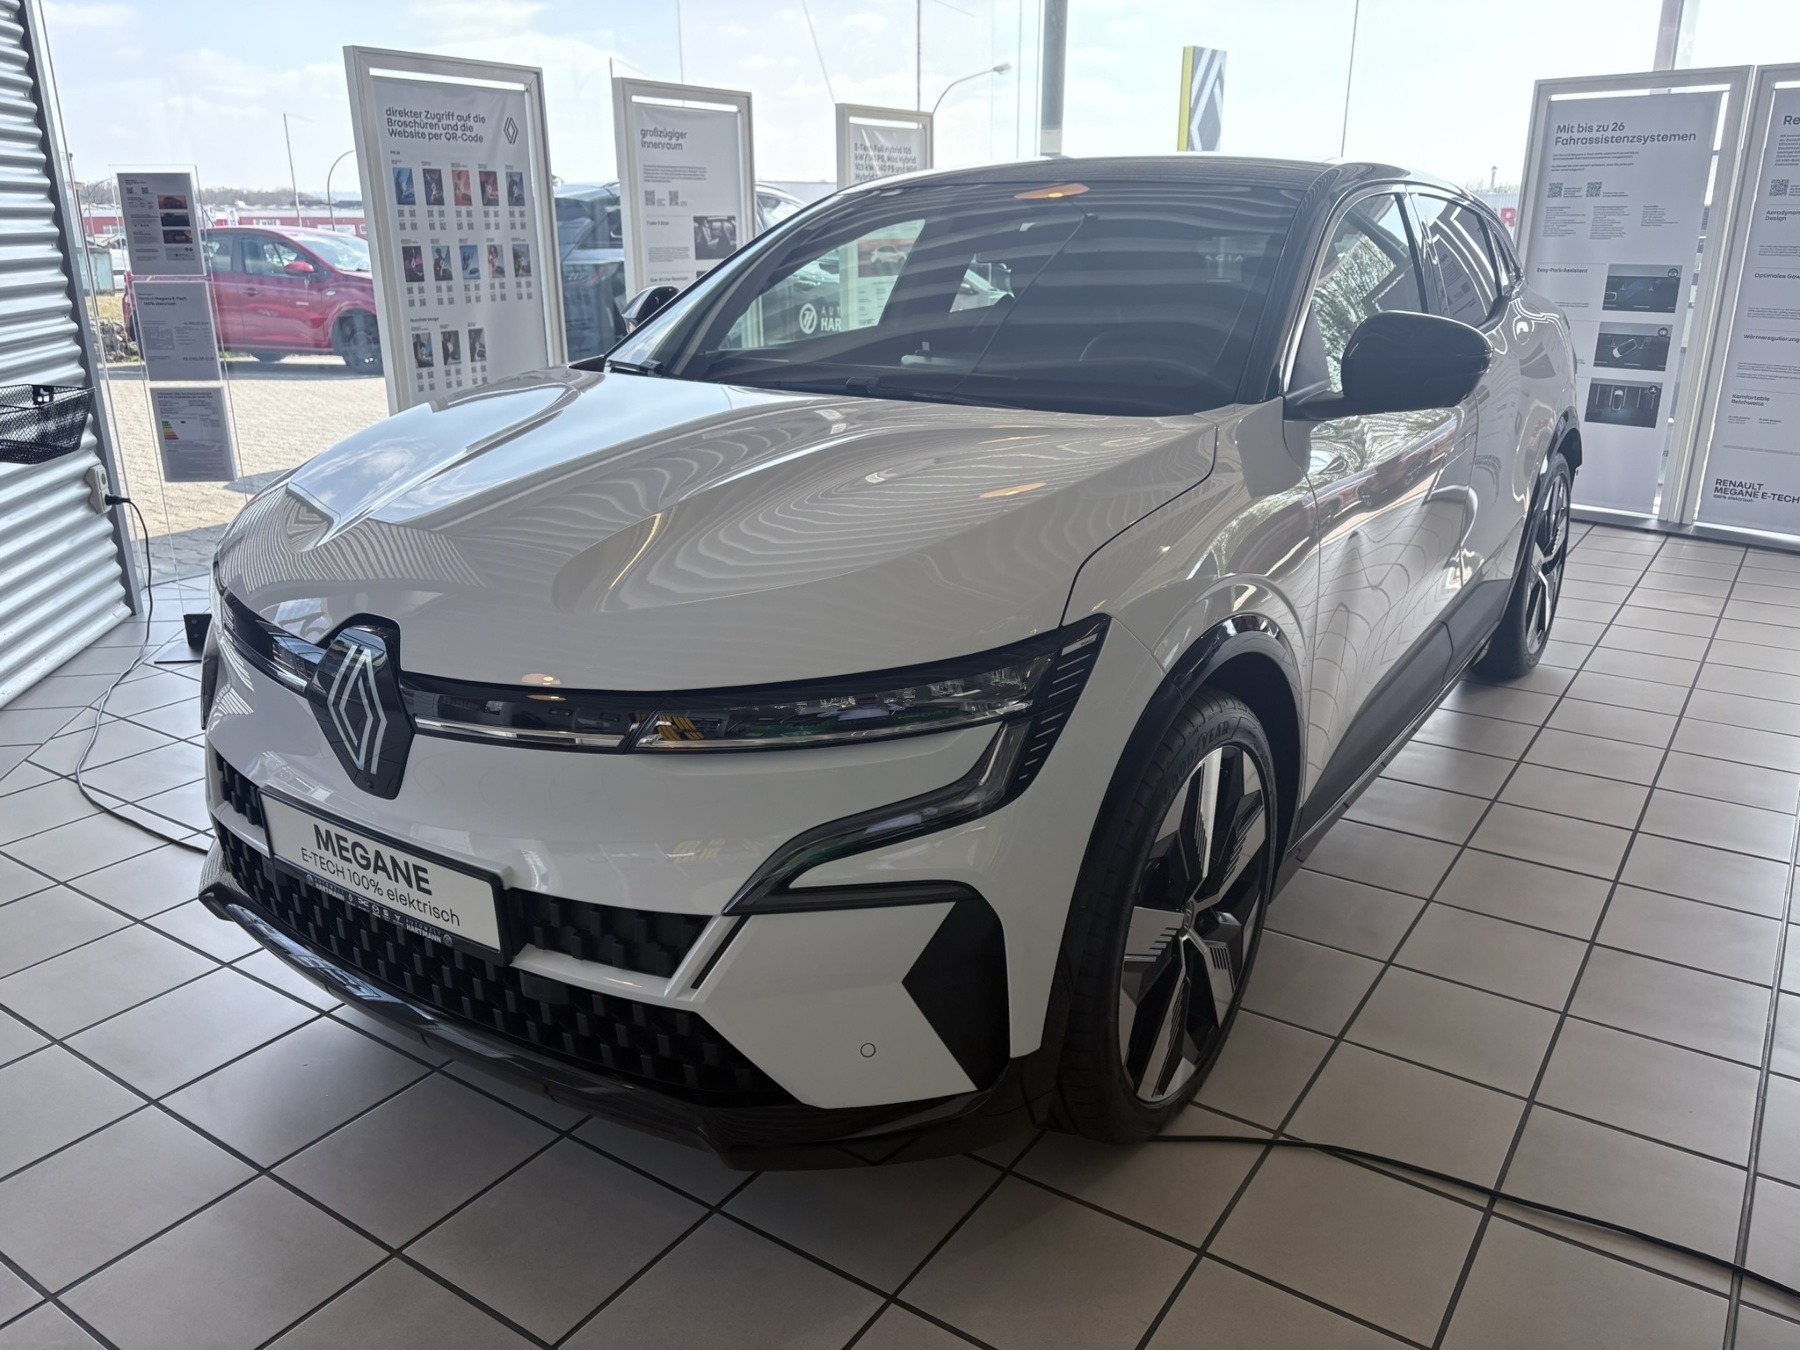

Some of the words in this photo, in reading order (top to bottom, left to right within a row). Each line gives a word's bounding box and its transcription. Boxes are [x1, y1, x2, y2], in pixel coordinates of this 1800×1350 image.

[386, 107, 422, 119] direkter
[424, 110, 454, 123] Zugriff
[457, 113, 471, 123] auf
[473, 114, 486, 124] die
[387, 118, 440, 131] Broschüren
[442, 121, 459, 132] und
[460, 122, 474, 133] die
[1556, 123, 1575, 134] Mit
[1577, 122, 1594, 133] bis
[1595, 124, 1609, 133] zu
[1611, 122, 1626, 132] 26
[388, 128, 426, 140] Website
[428, 131, 443, 142] per
[444, 132, 484, 144] QR-Code
[640, 127, 688, 141] großzügiger
[1554, 131, 1697, 147] Fahrassistenzsystemen
[641, 139, 683, 150] Innenraum
[1715, 478, 1764, 491] RENAULT
[1714, 486, 1759, 499] MEGANE
[1761, 492, 1800, 504] E-TECH
[313, 823, 433, 896] MEGANE
[301, 847, 346, 881] E-TECH
[348, 868, 384, 897] 100%
[386, 887, 460, 926] elektrisch
[406, 924, 442, 943] HARTMANN
